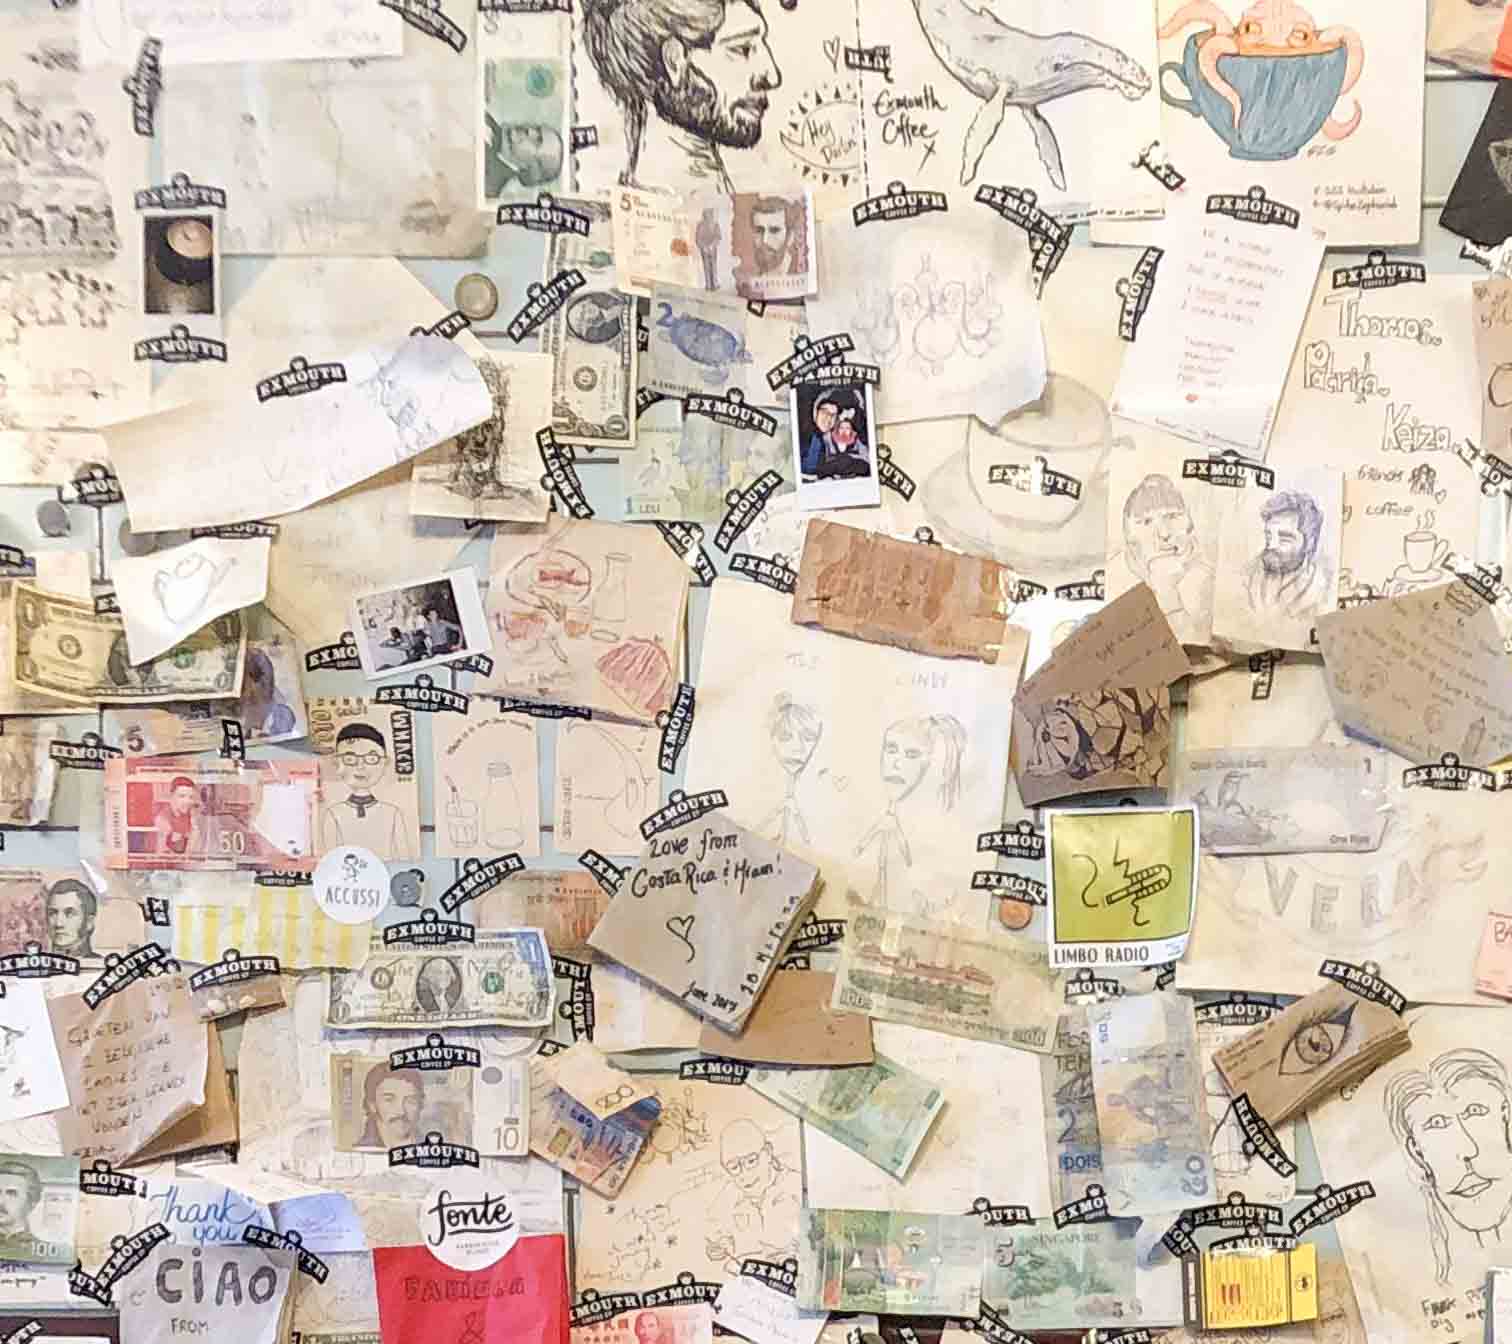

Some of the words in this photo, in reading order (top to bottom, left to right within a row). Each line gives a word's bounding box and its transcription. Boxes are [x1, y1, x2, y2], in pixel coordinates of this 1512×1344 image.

[873, 84, 949, 118] Exmouth
[882, 113, 939, 147] Coffee
[499, 206, 589, 232] EXMOUTH
[855, 192, 946, 221] EXMOUTH
[977, 185, 1062, 238] EXMOUTH
[1206, 197, 1297, 228] EXMOUTH
[1333, 263, 1425, 288] EXMOUTH
[510, 271, 584, 339] EXMOUTH
[1120, 249, 1161, 339] EXMOUTH
[769, 335, 852, 387] EXMOUTH
[259, 364, 345, 398] EXMOUTH
[686, 399, 775, 433] EXMOUTH
[1184, 461, 1273, 487] EXMOUTH
[717, 471, 783, 549] EXMOUTH
[731, 556, 795, 590] EXMOU
[308, 645, 357, 668] EXMO
[379, 686, 467, 711] EXMOUTH
[660, 685, 694, 772] EXMOUTH
[1404, 767, 1495, 788] EXMOUTH
[640, 792, 727, 837] EXMOUTH
[697, 828, 738, 862] from
[441, 854, 524, 908] EXMOUTH
[631, 867, 681, 898] Costa
[683, 861, 717, 895] Rica
[384, 922, 474, 943] EXMOUTH
[0, 957, 78, 973] XMOUTH
[1054, 945, 1097, 963] LIMBO
[1103, 944, 1150, 961] RADIO
[84, 945, 164, 1008] EXMOUTH
[192, 956, 279, 988] EXMOUTH
[1320, 961, 1405, 1009] EXMOUTH
[390, 1046, 480, 1067] EXMOUTH
[389, 1144, 479, 1167] EXMOUTH
[494, 1127, 519, 1151] 10
[427, 1190, 514, 1247] fonte
[1193, 1206, 1282, 1227] EXMOUTH
[1292, 1183, 1375, 1235] EXMOUTH
[100, 1225, 170, 1298] EXMOUTH
[170, 1318, 209, 1336] FROM
